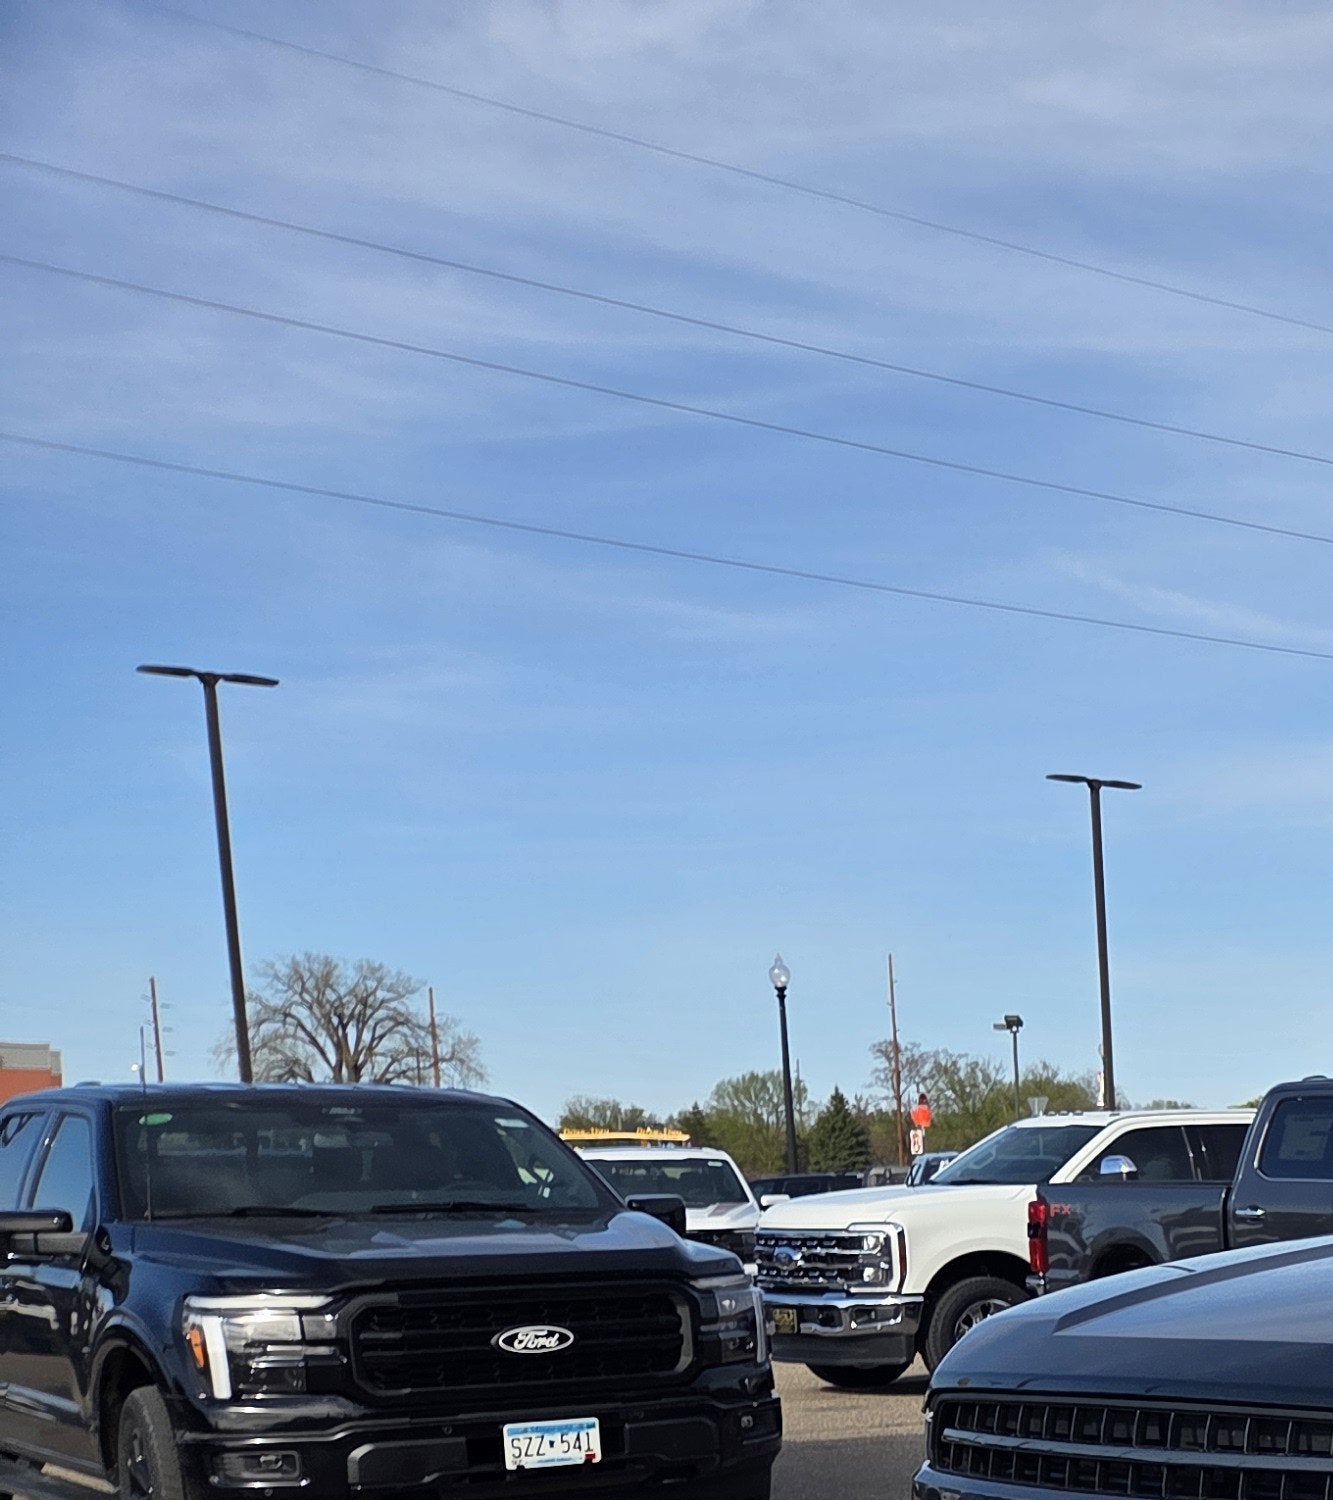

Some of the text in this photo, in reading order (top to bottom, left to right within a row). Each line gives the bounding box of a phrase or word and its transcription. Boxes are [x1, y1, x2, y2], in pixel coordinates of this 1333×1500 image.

[513, 1329, 560, 1350] Ford
[511, 1431, 594, 1459] SZZ 541
